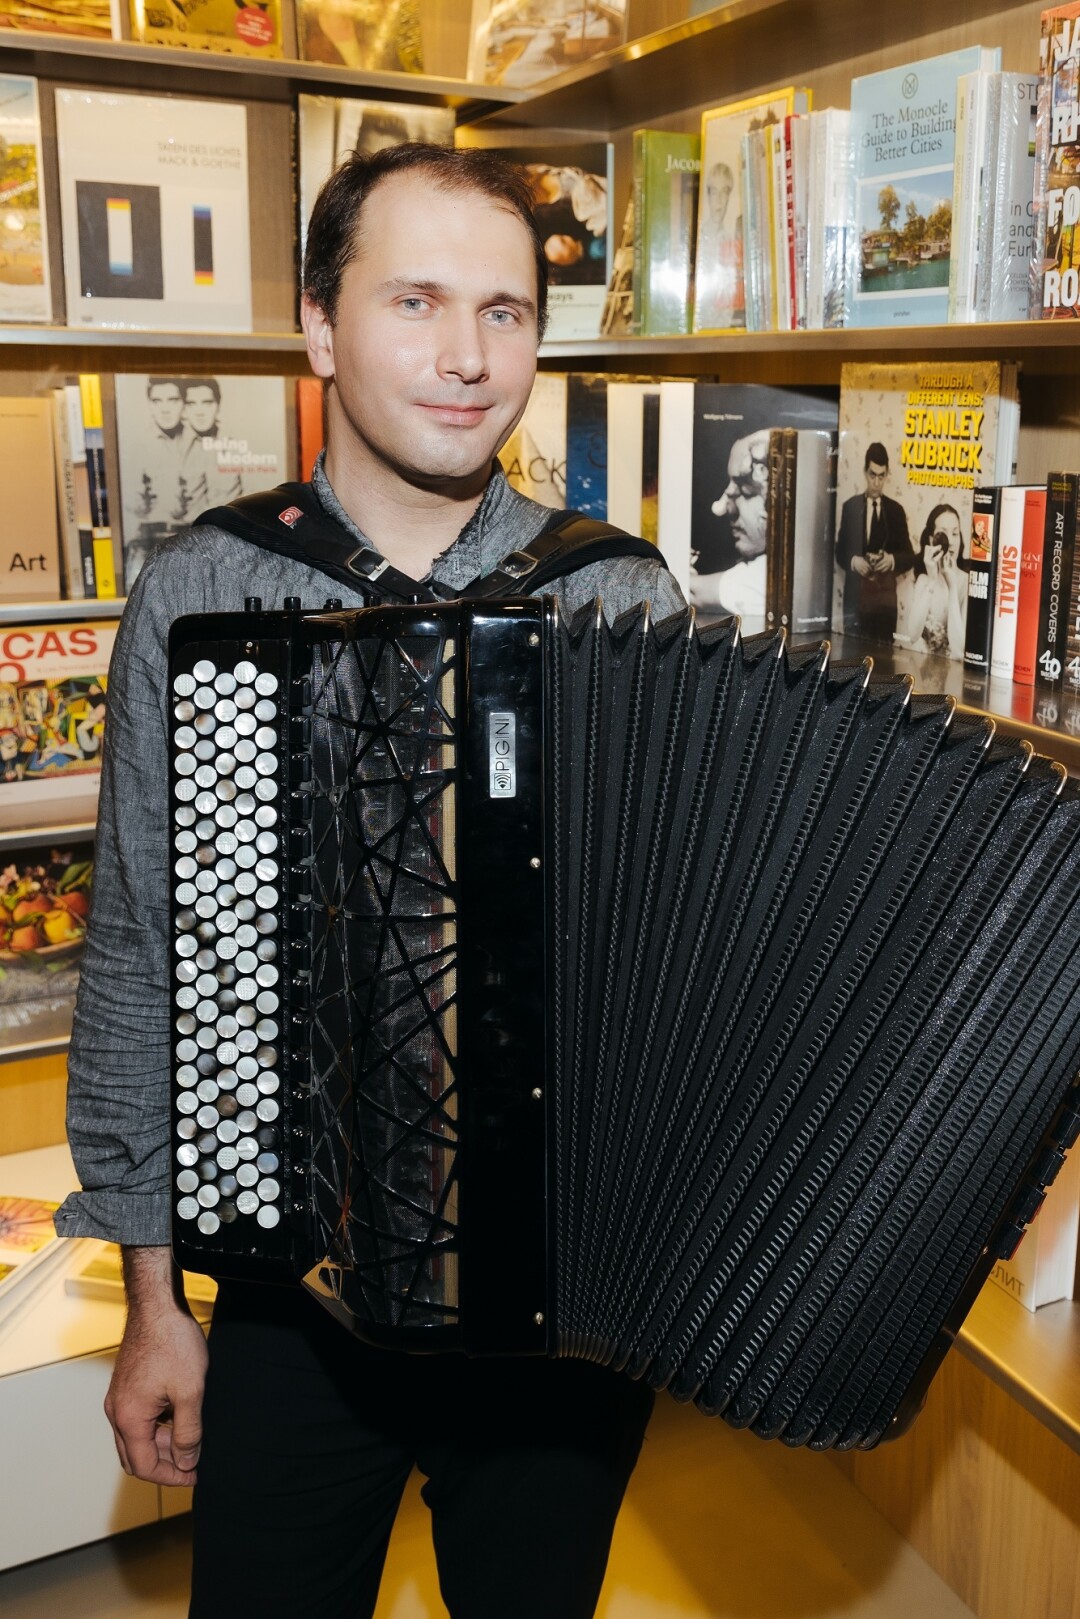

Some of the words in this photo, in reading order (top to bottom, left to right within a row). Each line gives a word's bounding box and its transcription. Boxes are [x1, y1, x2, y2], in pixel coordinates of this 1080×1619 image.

[872, 113, 895, 129] The
[898, 98, 948, 124] Monocle
[861, 129, 894, 149] Guide
[896, 129, 908, 141] to
[875, 146, 908, 162] Better
[910, 137, 943, 155] Cities
[1010, 200, 1022, 217] in
[920, 375, 965, 390] THROUGH
[966, 374, 974, 390] A
[908, 391, 956, 407] DIFFERENT
[957, 392, 984, 408] LENS:
[904, 408, 985, 441] STANLEY
[202, 436, 248, 453] Being
[901, 440, 983, 474] KUBRICK
[217, 450, 277, 465] Modern
[907, 470, 975, 489] PHOTOGRAPHS
[1056, 511, 1065, 538] ART
[9, 553, 47, 572] Art
[1052, 542, 1063, 591] RECORD
[968, 571, 989, 587] FILM
[998, 545, 1019, 618] SMALL
[968, 584, 988, 600] NOIR
[1048, 594, 1059, 643] COVERS
[2, 628, 98, 661] CAS
[1038, 649, 1061, 675] 40
[495, 718, 510, 771] PIGINI
